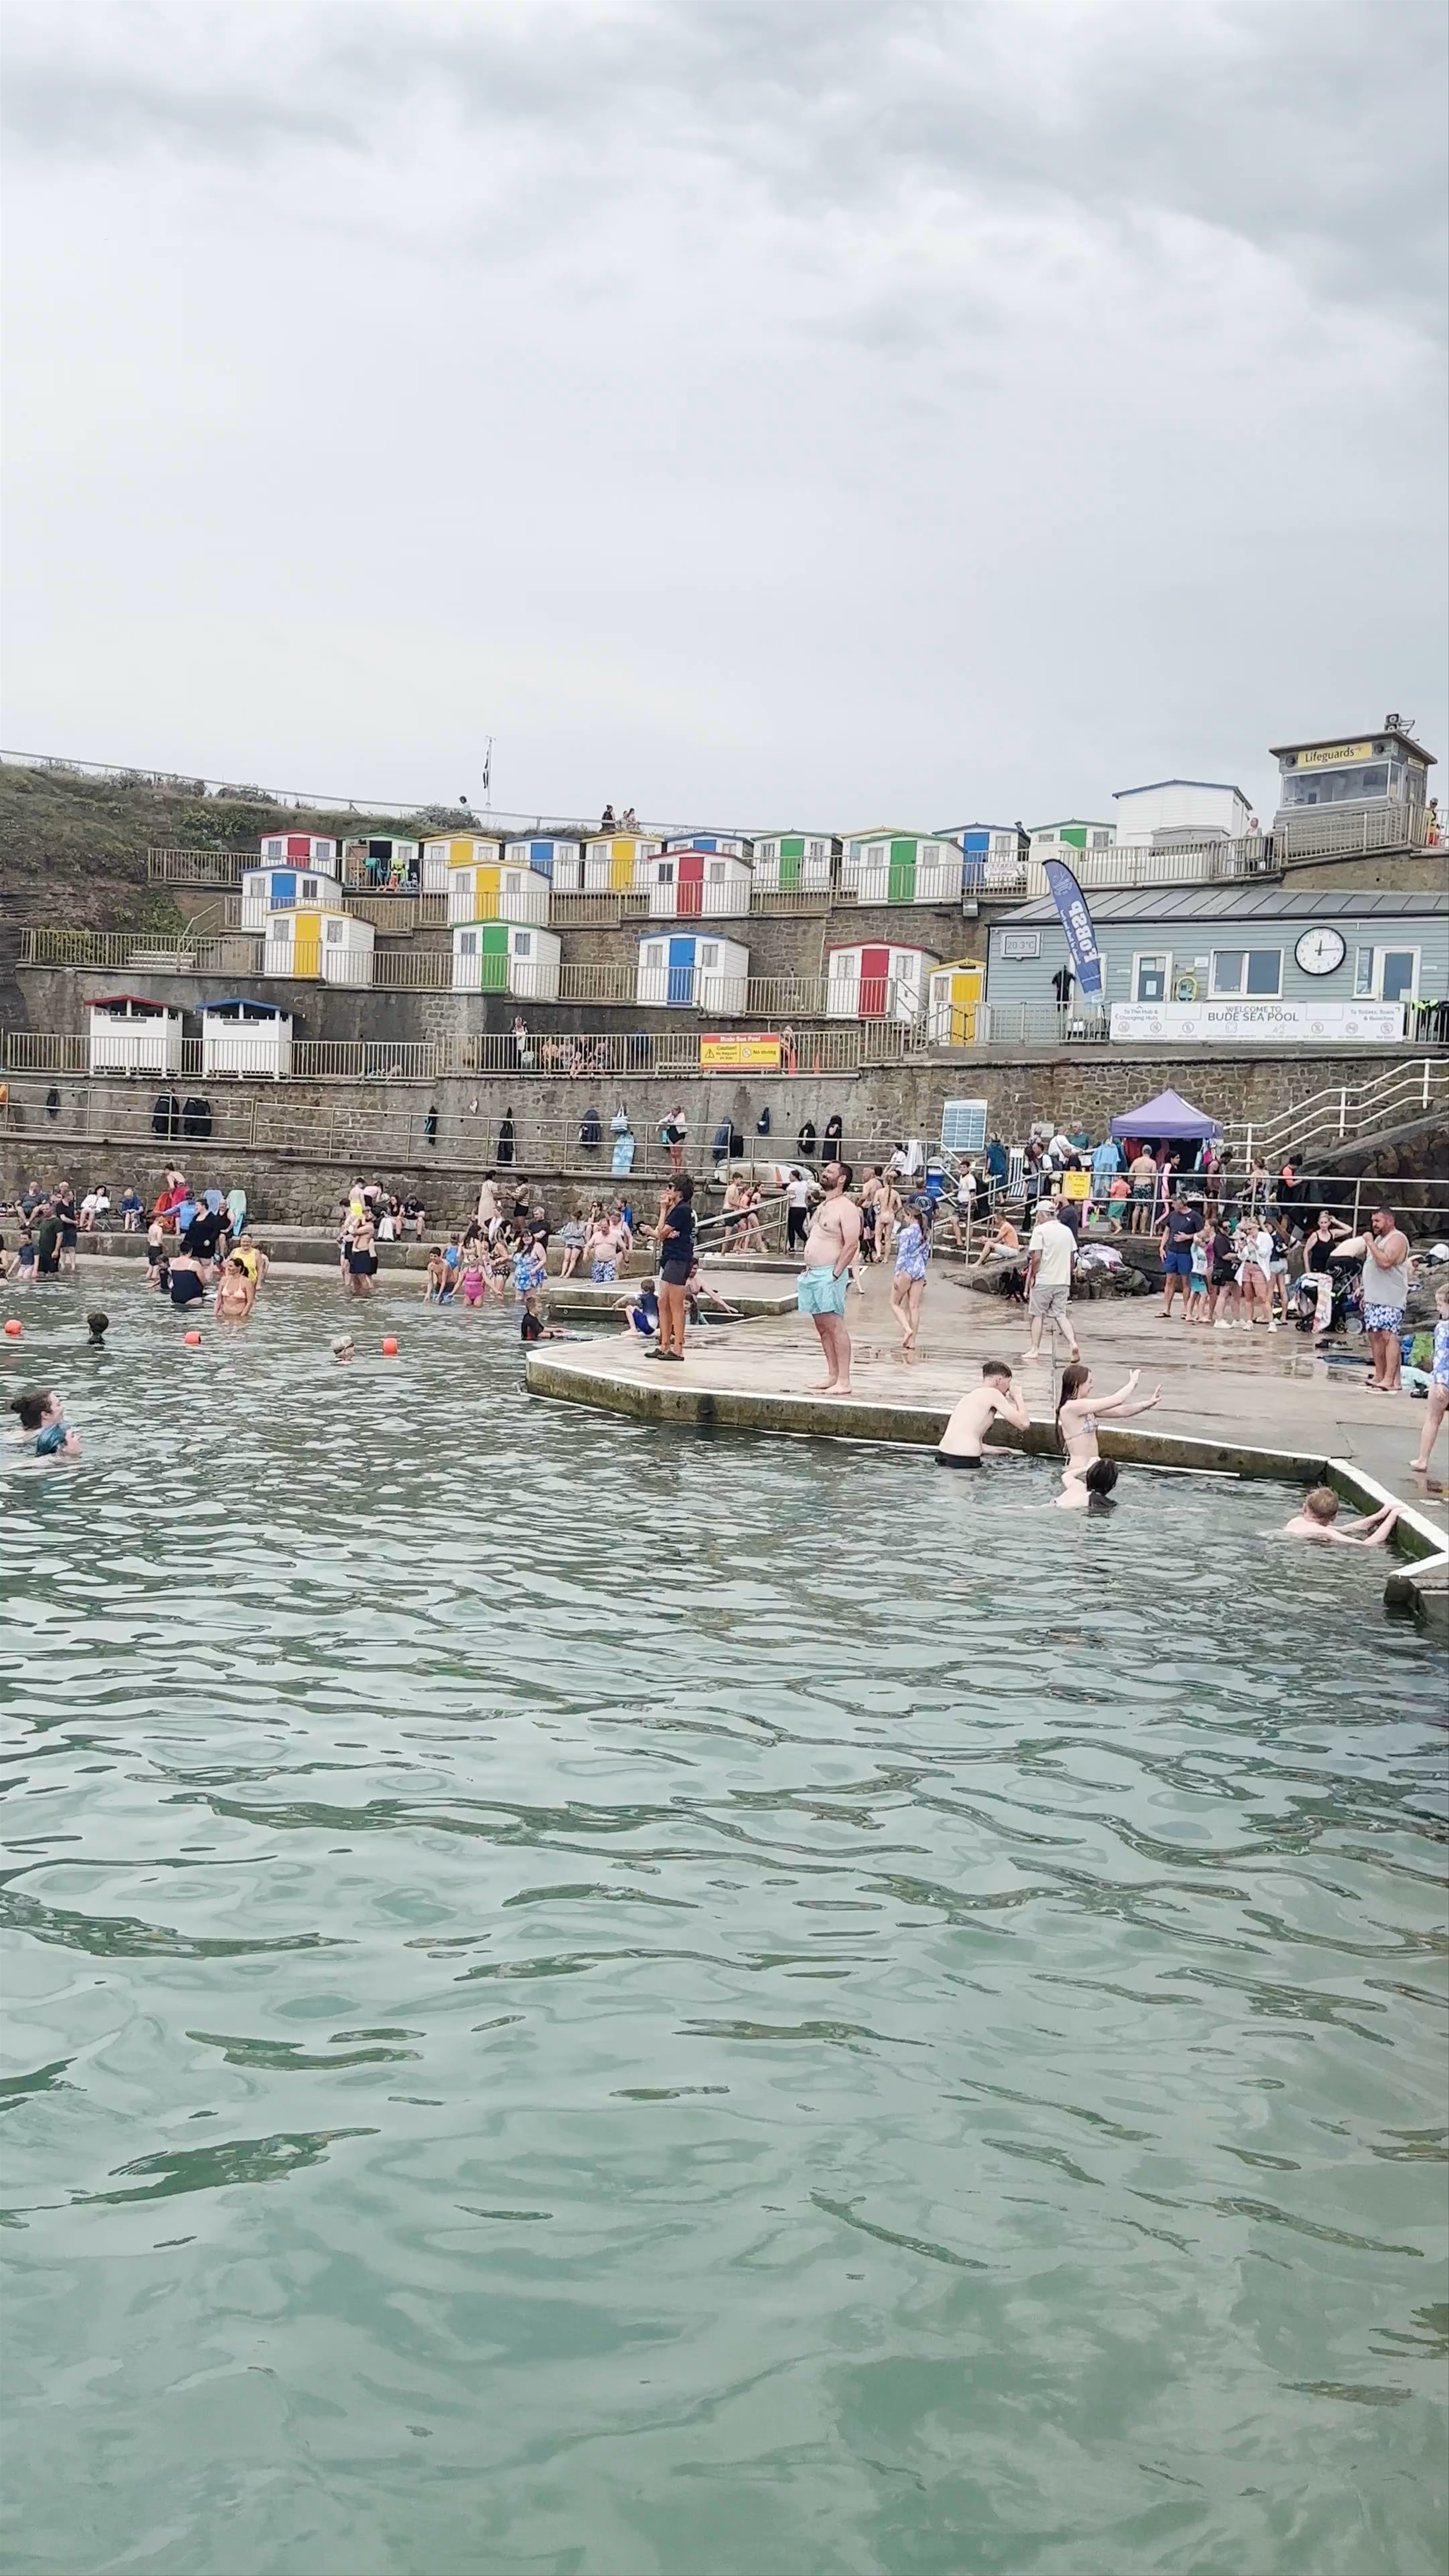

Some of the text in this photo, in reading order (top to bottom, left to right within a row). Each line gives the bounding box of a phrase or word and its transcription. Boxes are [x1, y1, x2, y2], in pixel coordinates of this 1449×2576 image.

[1305, 747, 1354, 763] Lifeguards
[1208, 1012, 1299, 1021] BUDE SEA POOL
